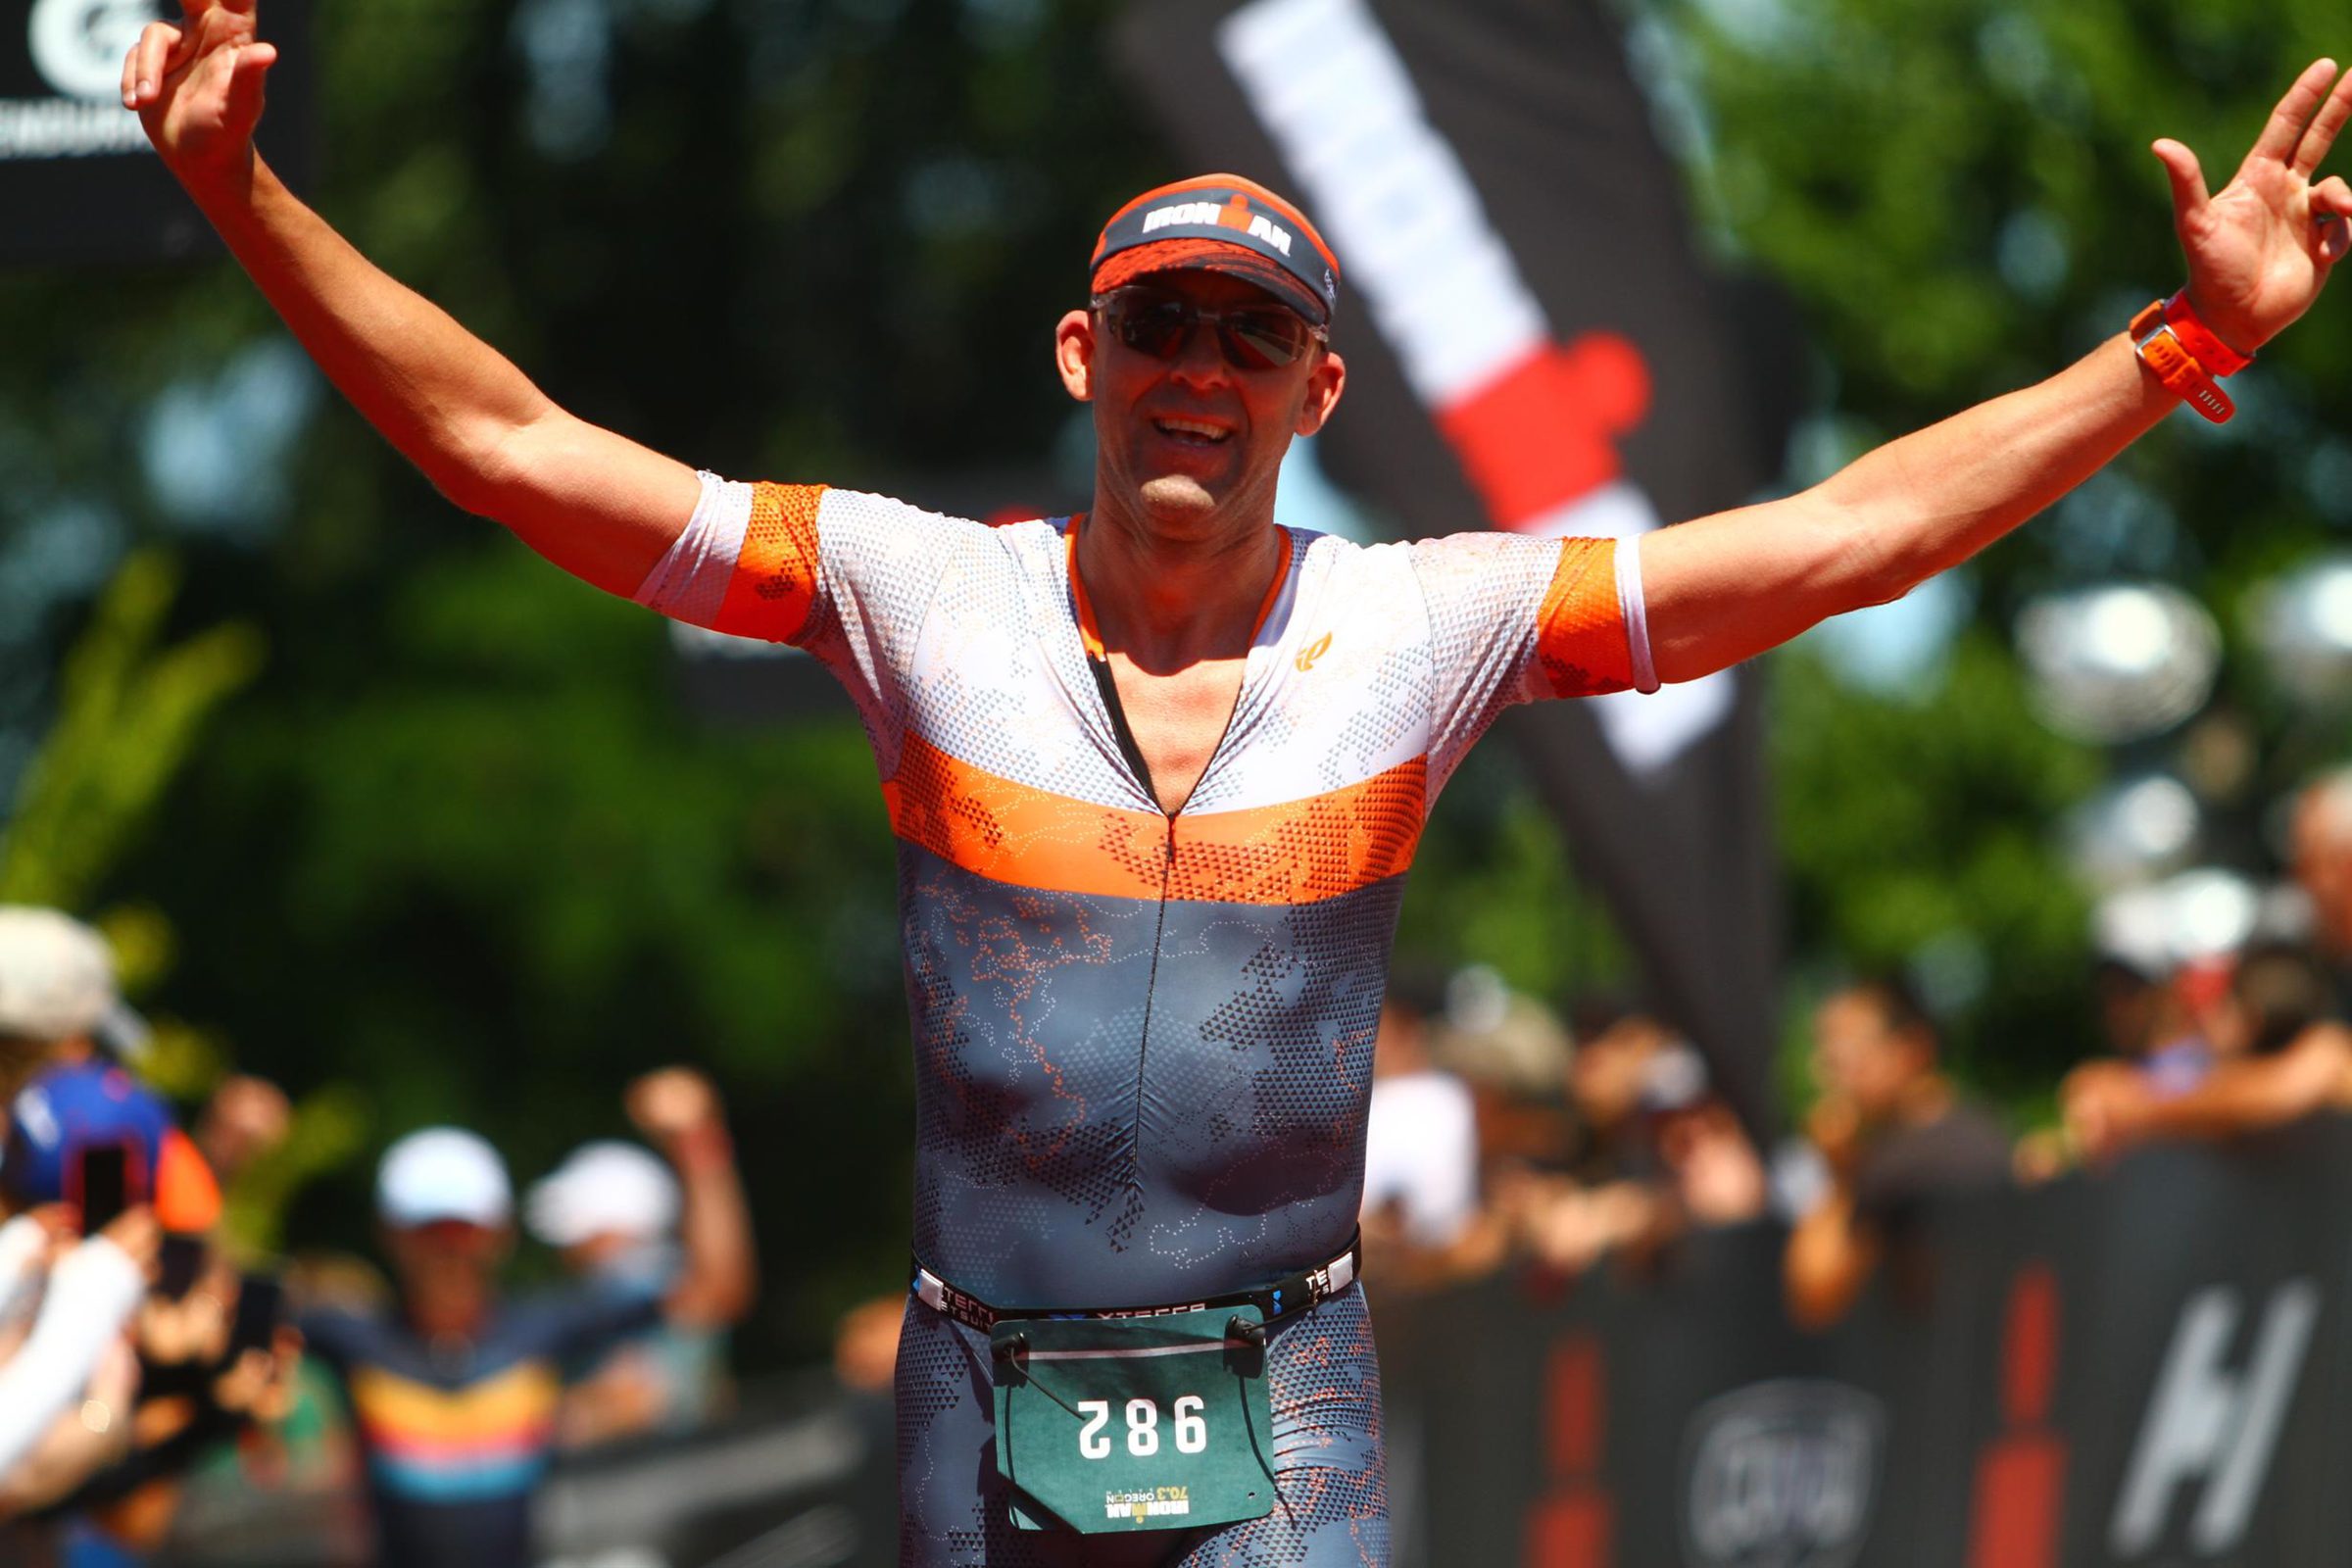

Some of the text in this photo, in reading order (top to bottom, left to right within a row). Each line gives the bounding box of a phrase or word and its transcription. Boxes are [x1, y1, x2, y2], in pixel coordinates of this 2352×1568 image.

[1078, 1396, 1206, 1459] 982
[1156, 1486, 1189, 1500] 70.3
[1104, 1500, 1190, 1524] IRONMAN
